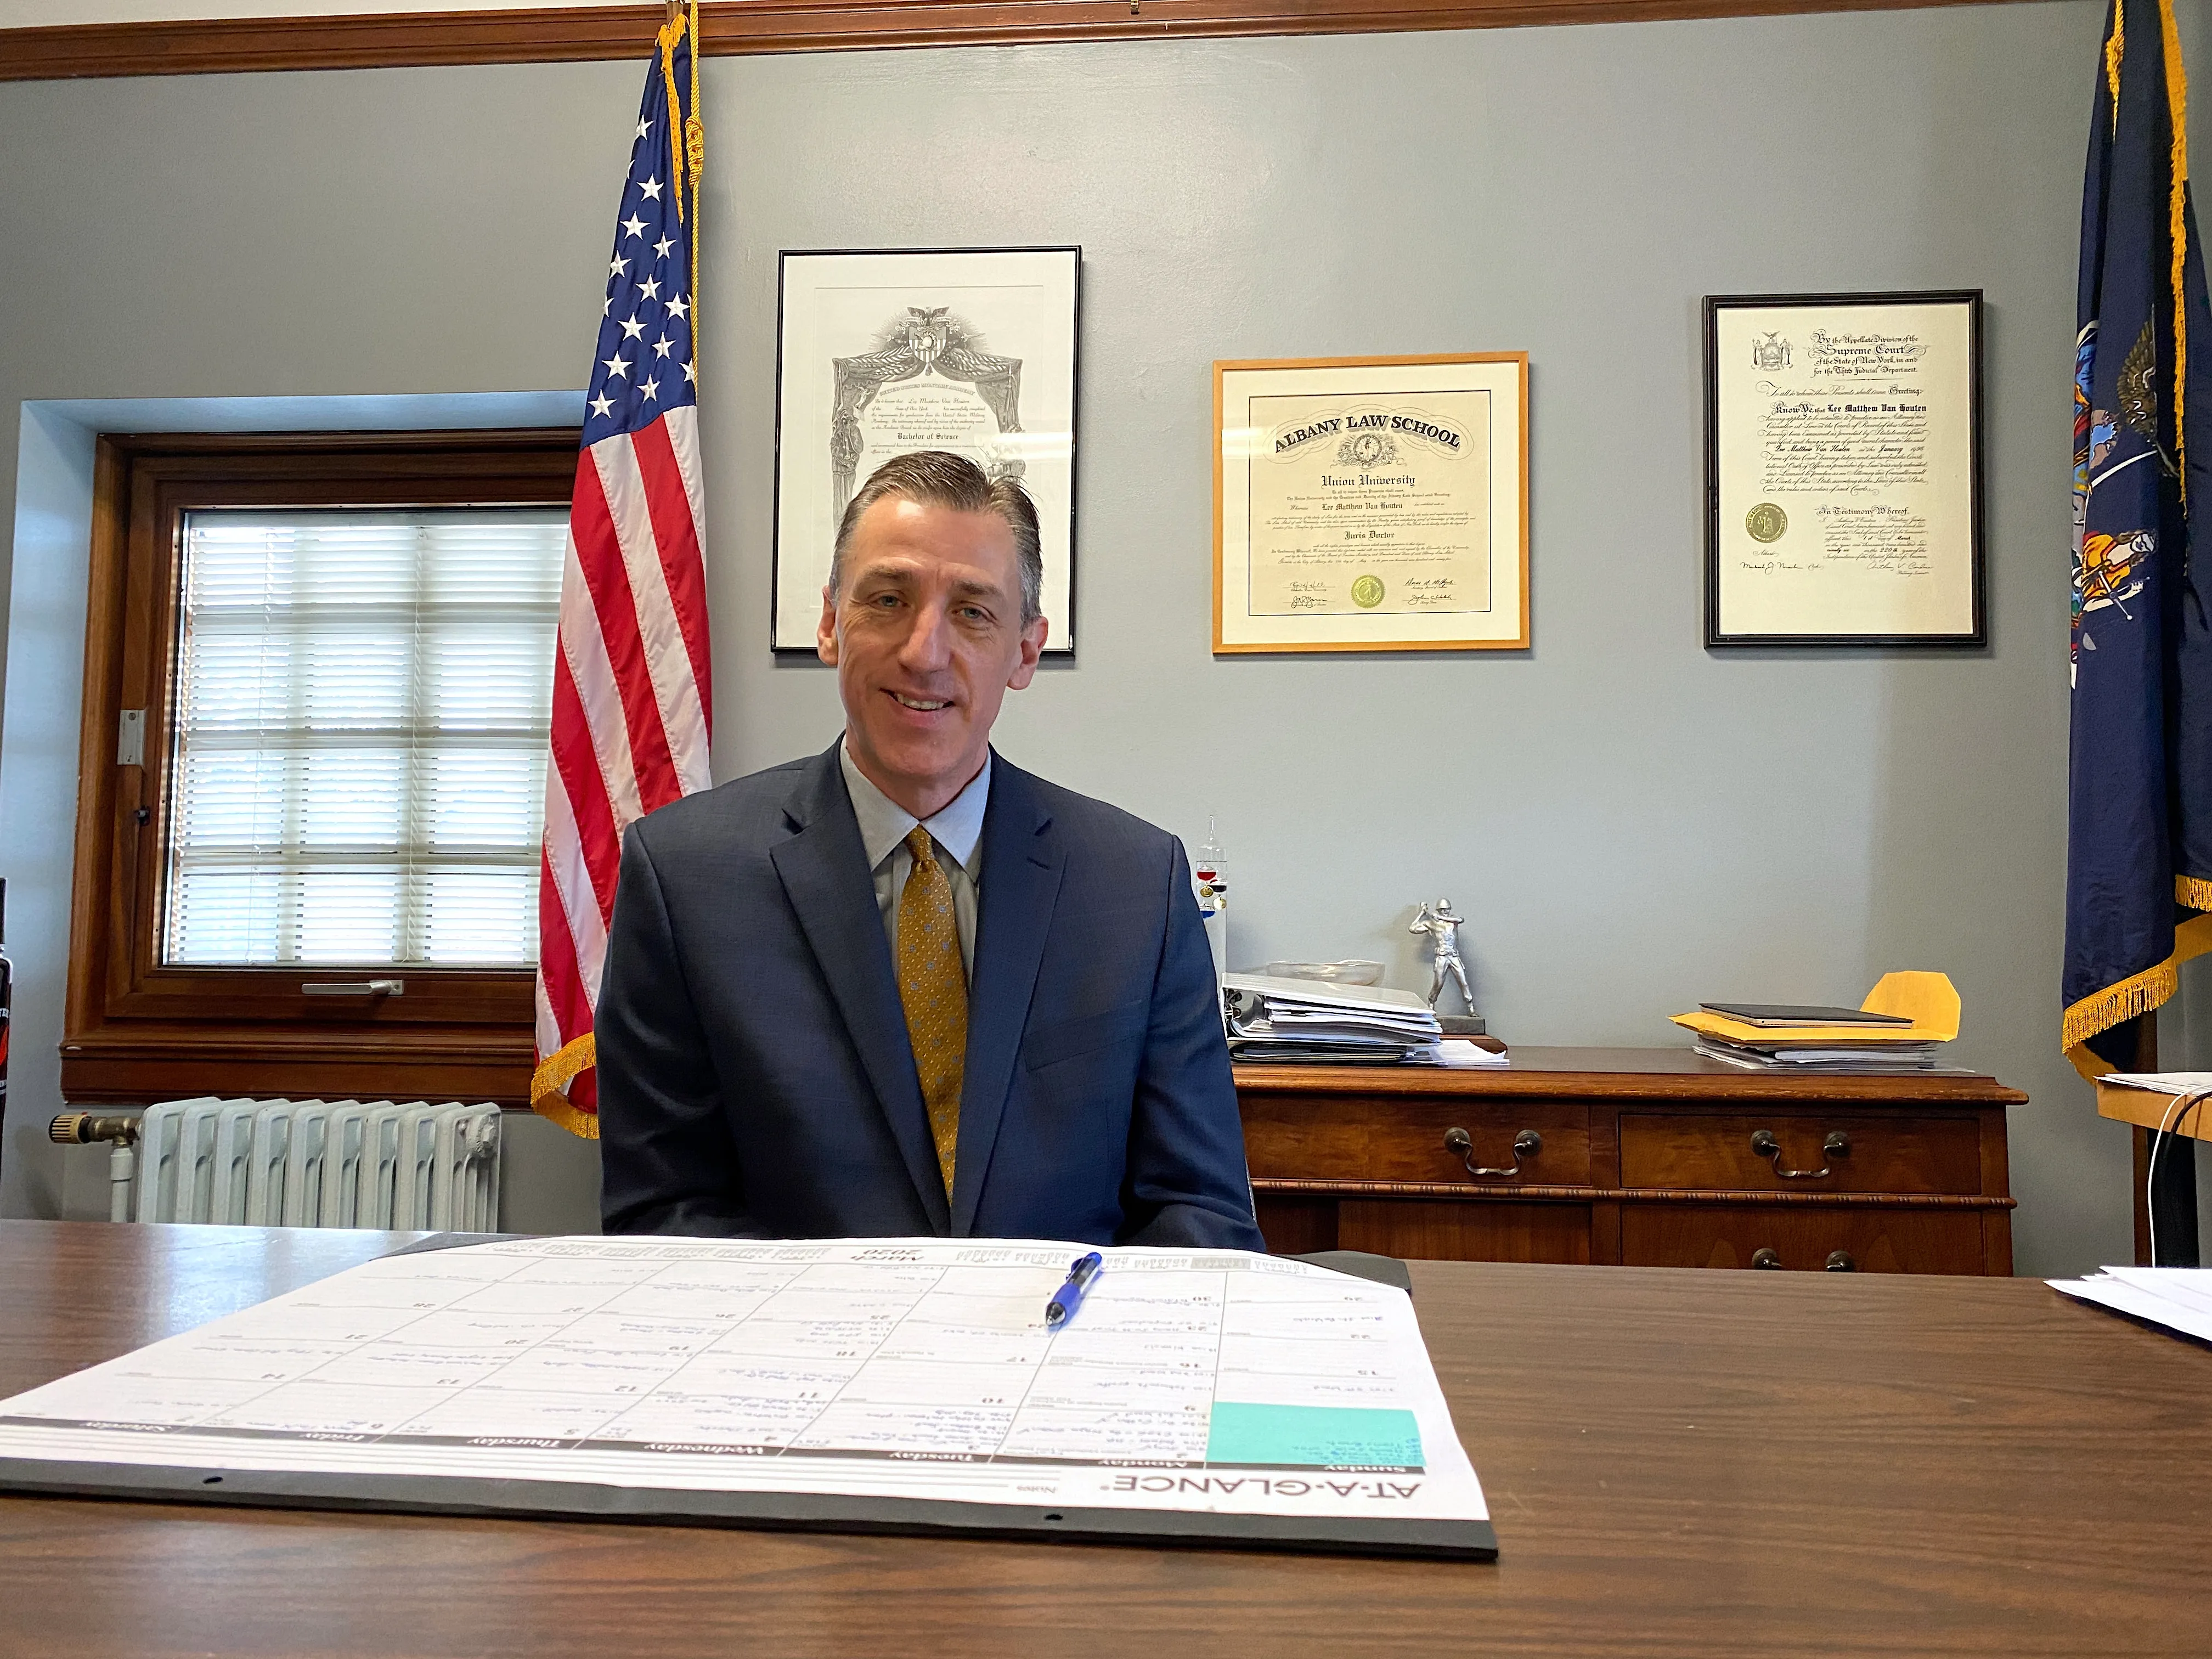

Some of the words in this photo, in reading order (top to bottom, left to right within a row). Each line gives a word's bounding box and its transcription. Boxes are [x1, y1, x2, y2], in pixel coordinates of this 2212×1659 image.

[1811, 331, 1830, 343] By
[1842, 334, 1872, 344] Appellate
[1872, 334, 1901, 342] Division
[1910, 335, 1918, 343] the
[1809, 344, 1871, 358] Supreme
[1874, 344, 1905, 356] Court
[1814, 357, 1823, 366] of
[1810, 368, 1822, 377] for
[1825, 368, 1833, 376] the
[1833, 366, 1852, 376] Third
[1854, 366, 1878, 375] Judicial
[1771, 402, 1800, 415] Know
[1844, 404, 1878, 413] Matthew
[1881, 404, 1897, 412] Van
[1899, 404, 1926, 413] Houten
[1276, 418, 1341, 453] ALBANY
[1346, 415, 1390, 430] LAW
[1391, 416, 1460, 450] SCHOOL
[1878, 444, 1903, 454] January
[1321, 476, 1355, 489] Union
[1358, 475, 1415, 488] University
[1336, 503, 1363, 511] Matthew
[1380, 502, 1403, 510] Houten
[1833, 507, 1872, 516] Testimony
[1344, 531, 1366, 540] Juris
[1368, 530, 1395, 540] Doctor
[298, 1432, 365, 1442] Friday
[466, 1437, 561, 1448] Thursday
[644, 1443, 764, 1455] Wednesday
[889, 1452, 974, 1462] Tuesday
[1098, 1460, 1188, 1468] Monday
[1323, 1464, 1407, 1474] Sunday
[1016, 1485, 1057, 1494] Notes
